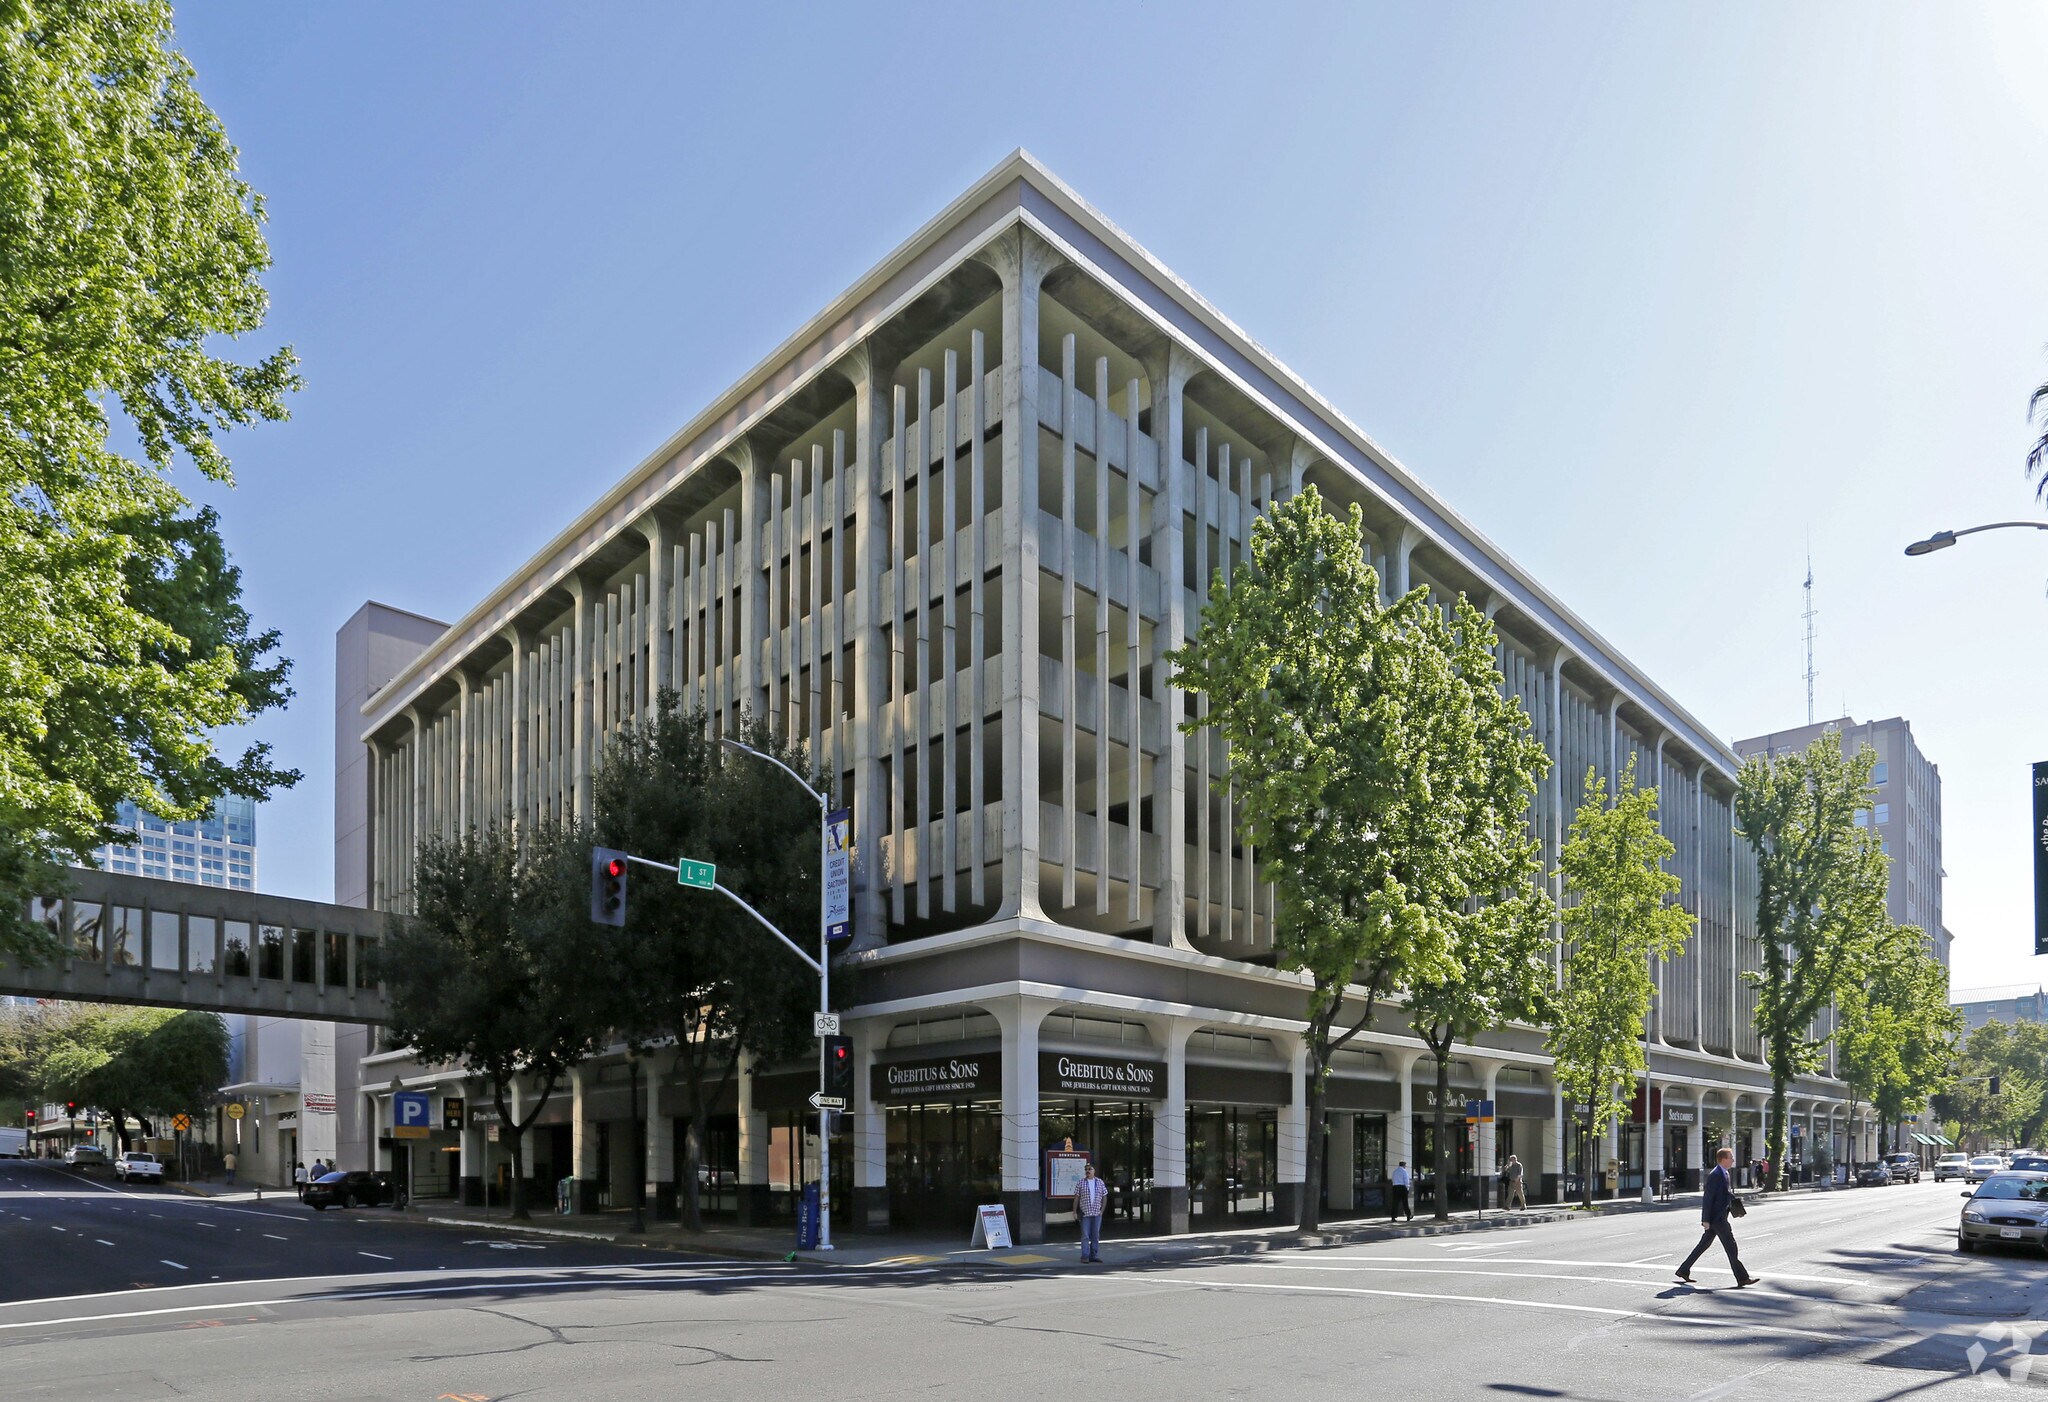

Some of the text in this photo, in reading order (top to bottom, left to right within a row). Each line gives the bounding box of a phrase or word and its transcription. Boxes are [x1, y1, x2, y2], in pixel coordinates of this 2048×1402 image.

[830, 857, 845, 869] CREDIT
[687, 866, 707, 880] L ST
[830, 868, 844, 879] UNION
[827, 878, 847, 890] SACTOWN
[888, 1060, 979, 1084] GREBITUS & SONS
[1058, 1057, 1154, 1083] GREBITUS & SONS
[936, 1083, 951, 1091] HOUSE
[951, 1082, 965, 1090] SINCE
[1073, 1081, 1096, 1090] JEWELERS
[1101, 1083, 1112, 1091] GIFT
[1112, 1084, 1127, 1092] HOUSE
[1127, 1085, 1141, 1093] SINCE
[448, 1101, 459, 1109] PAY
[1574, 1104, 1582, 1113] CAFE
[402, 1101, 422, 1125] P
[446, 1109, 461, 1117] HERE
